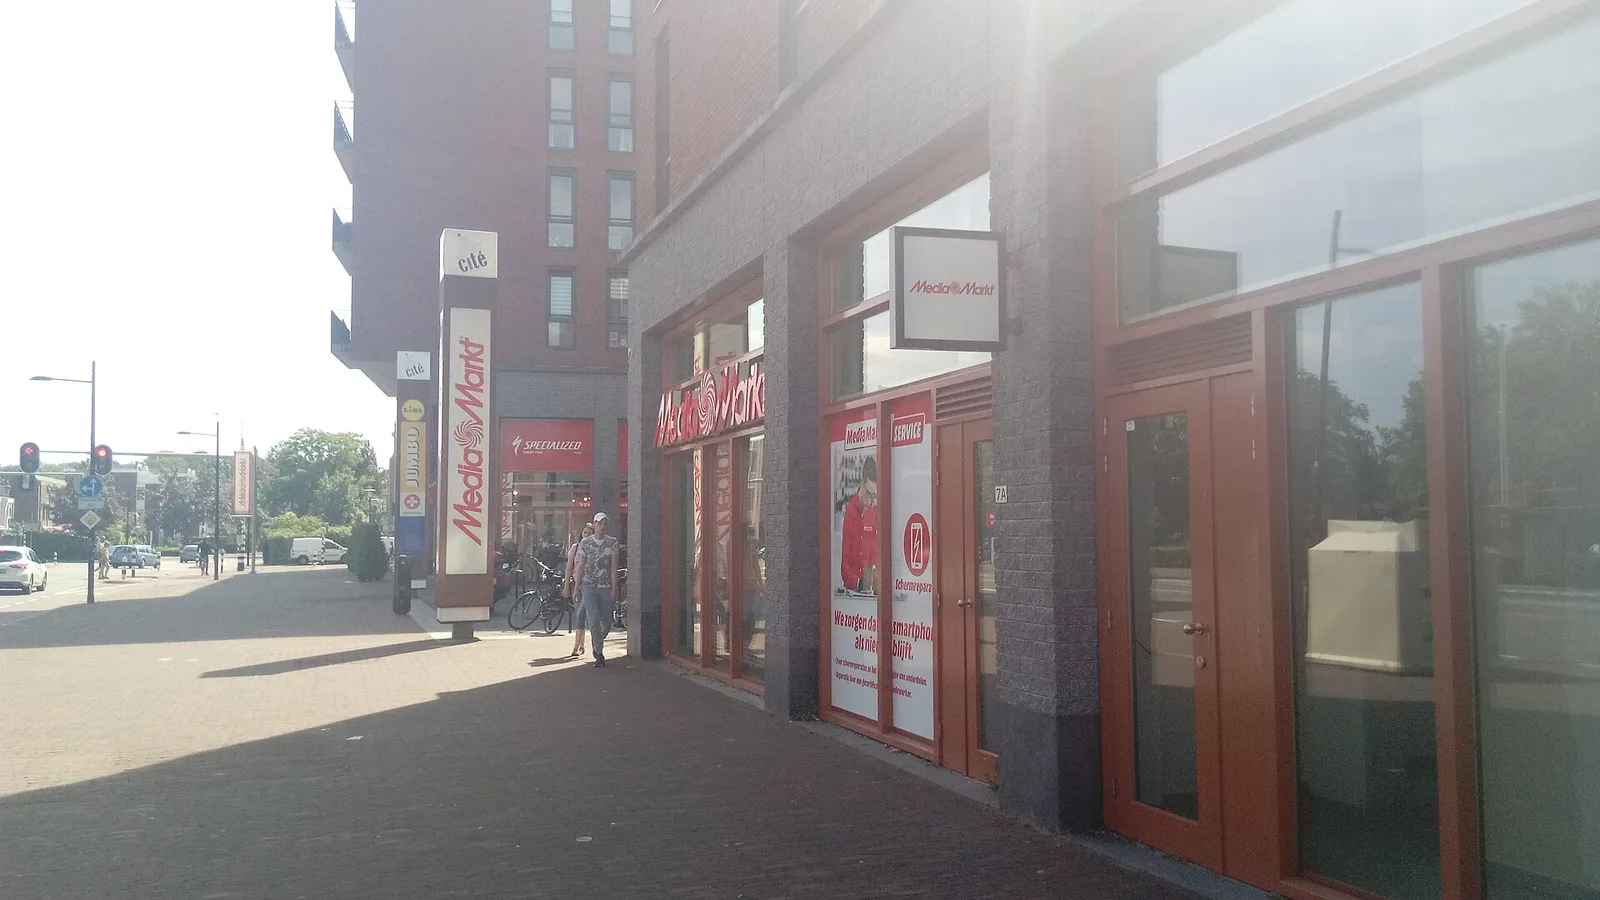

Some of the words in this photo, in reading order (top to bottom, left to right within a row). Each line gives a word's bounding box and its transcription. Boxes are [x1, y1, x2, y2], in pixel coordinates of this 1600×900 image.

[458, 250, 488, 273] cité
[846, 425, 877, 445] MediaMa
[893, 421, 922, 442] SERVICE
[523, 440, 582, 450] SPECIALIZED
[406, 426, 420, 489] JUMBO
[996, 488, 1007, 501] 7A
[895, 578, 933, 594] Schermrepara
[834, 610, 844, 626] We
[845, 613, 867, 632] zorgen
[868, 615, 879, 632] da
[855, 633, 864, 651] als
[865, 636, 879, 653] nie
